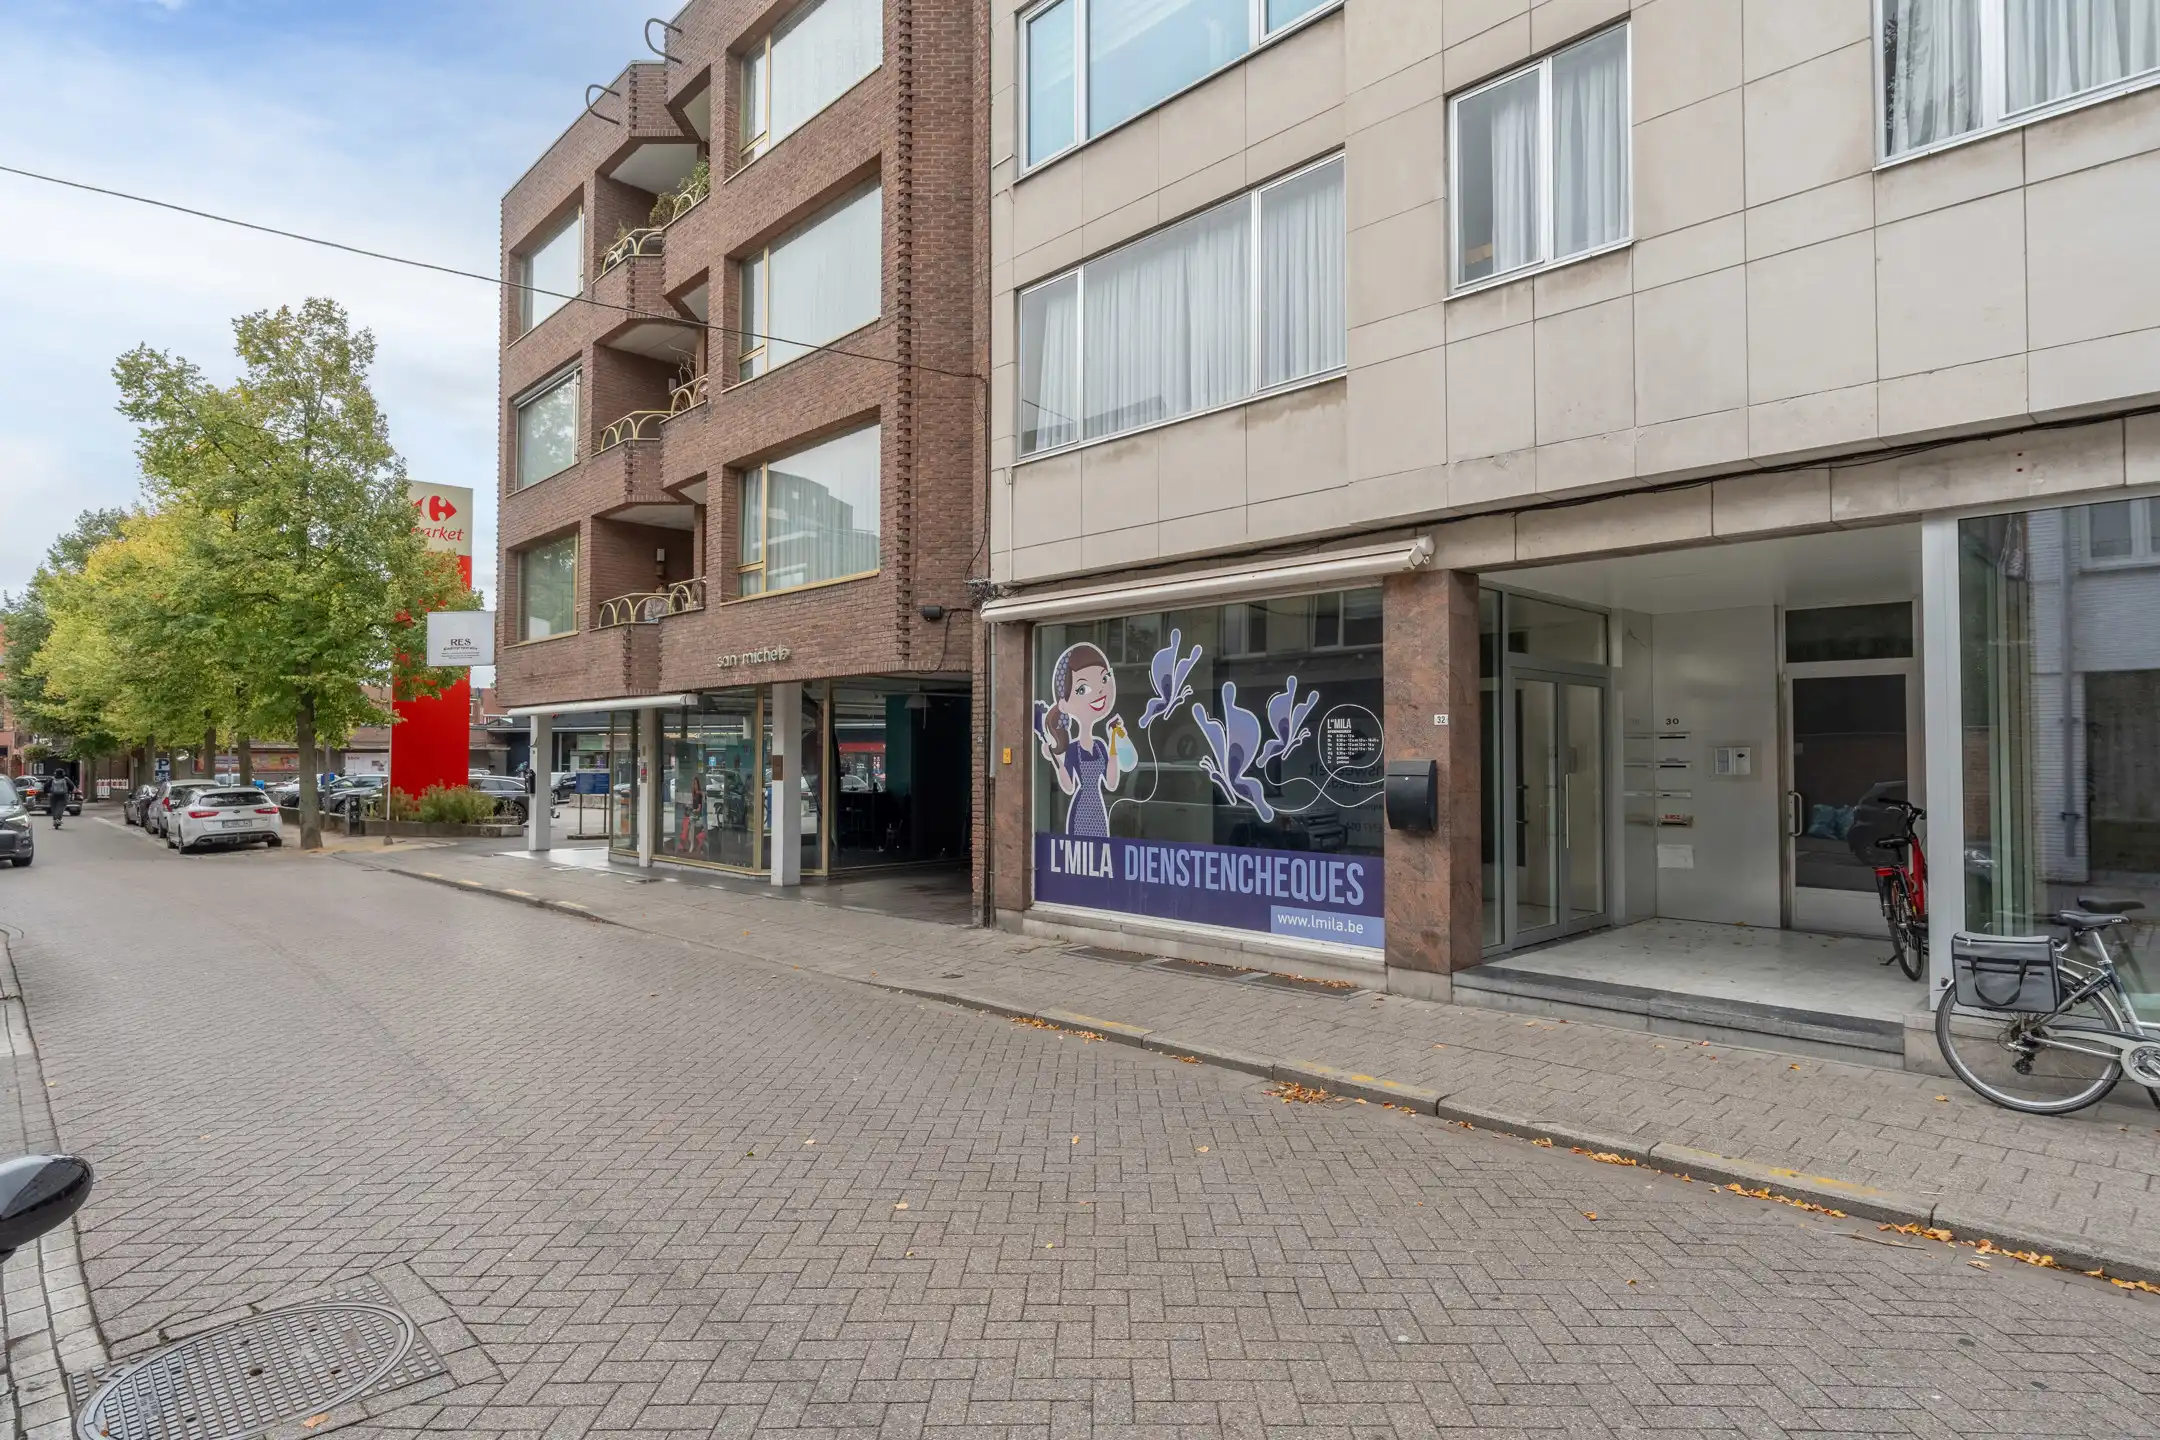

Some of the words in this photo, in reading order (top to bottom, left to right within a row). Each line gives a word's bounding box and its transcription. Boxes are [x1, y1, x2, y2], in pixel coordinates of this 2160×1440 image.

[450, 638, 472, 646] RES
[717, 654, 737, 667] san
[1436, 715, 1446, 724] 32
[1665, 717, 1680, 726] 30
[158, 758, 170, 770] P
[1050, 838, 1114, 879] L'MILA
[1124, 844, 1366, 906] DIENSTENCHEQUES
[1277, 911, 1365, 935] www.lmila.be
